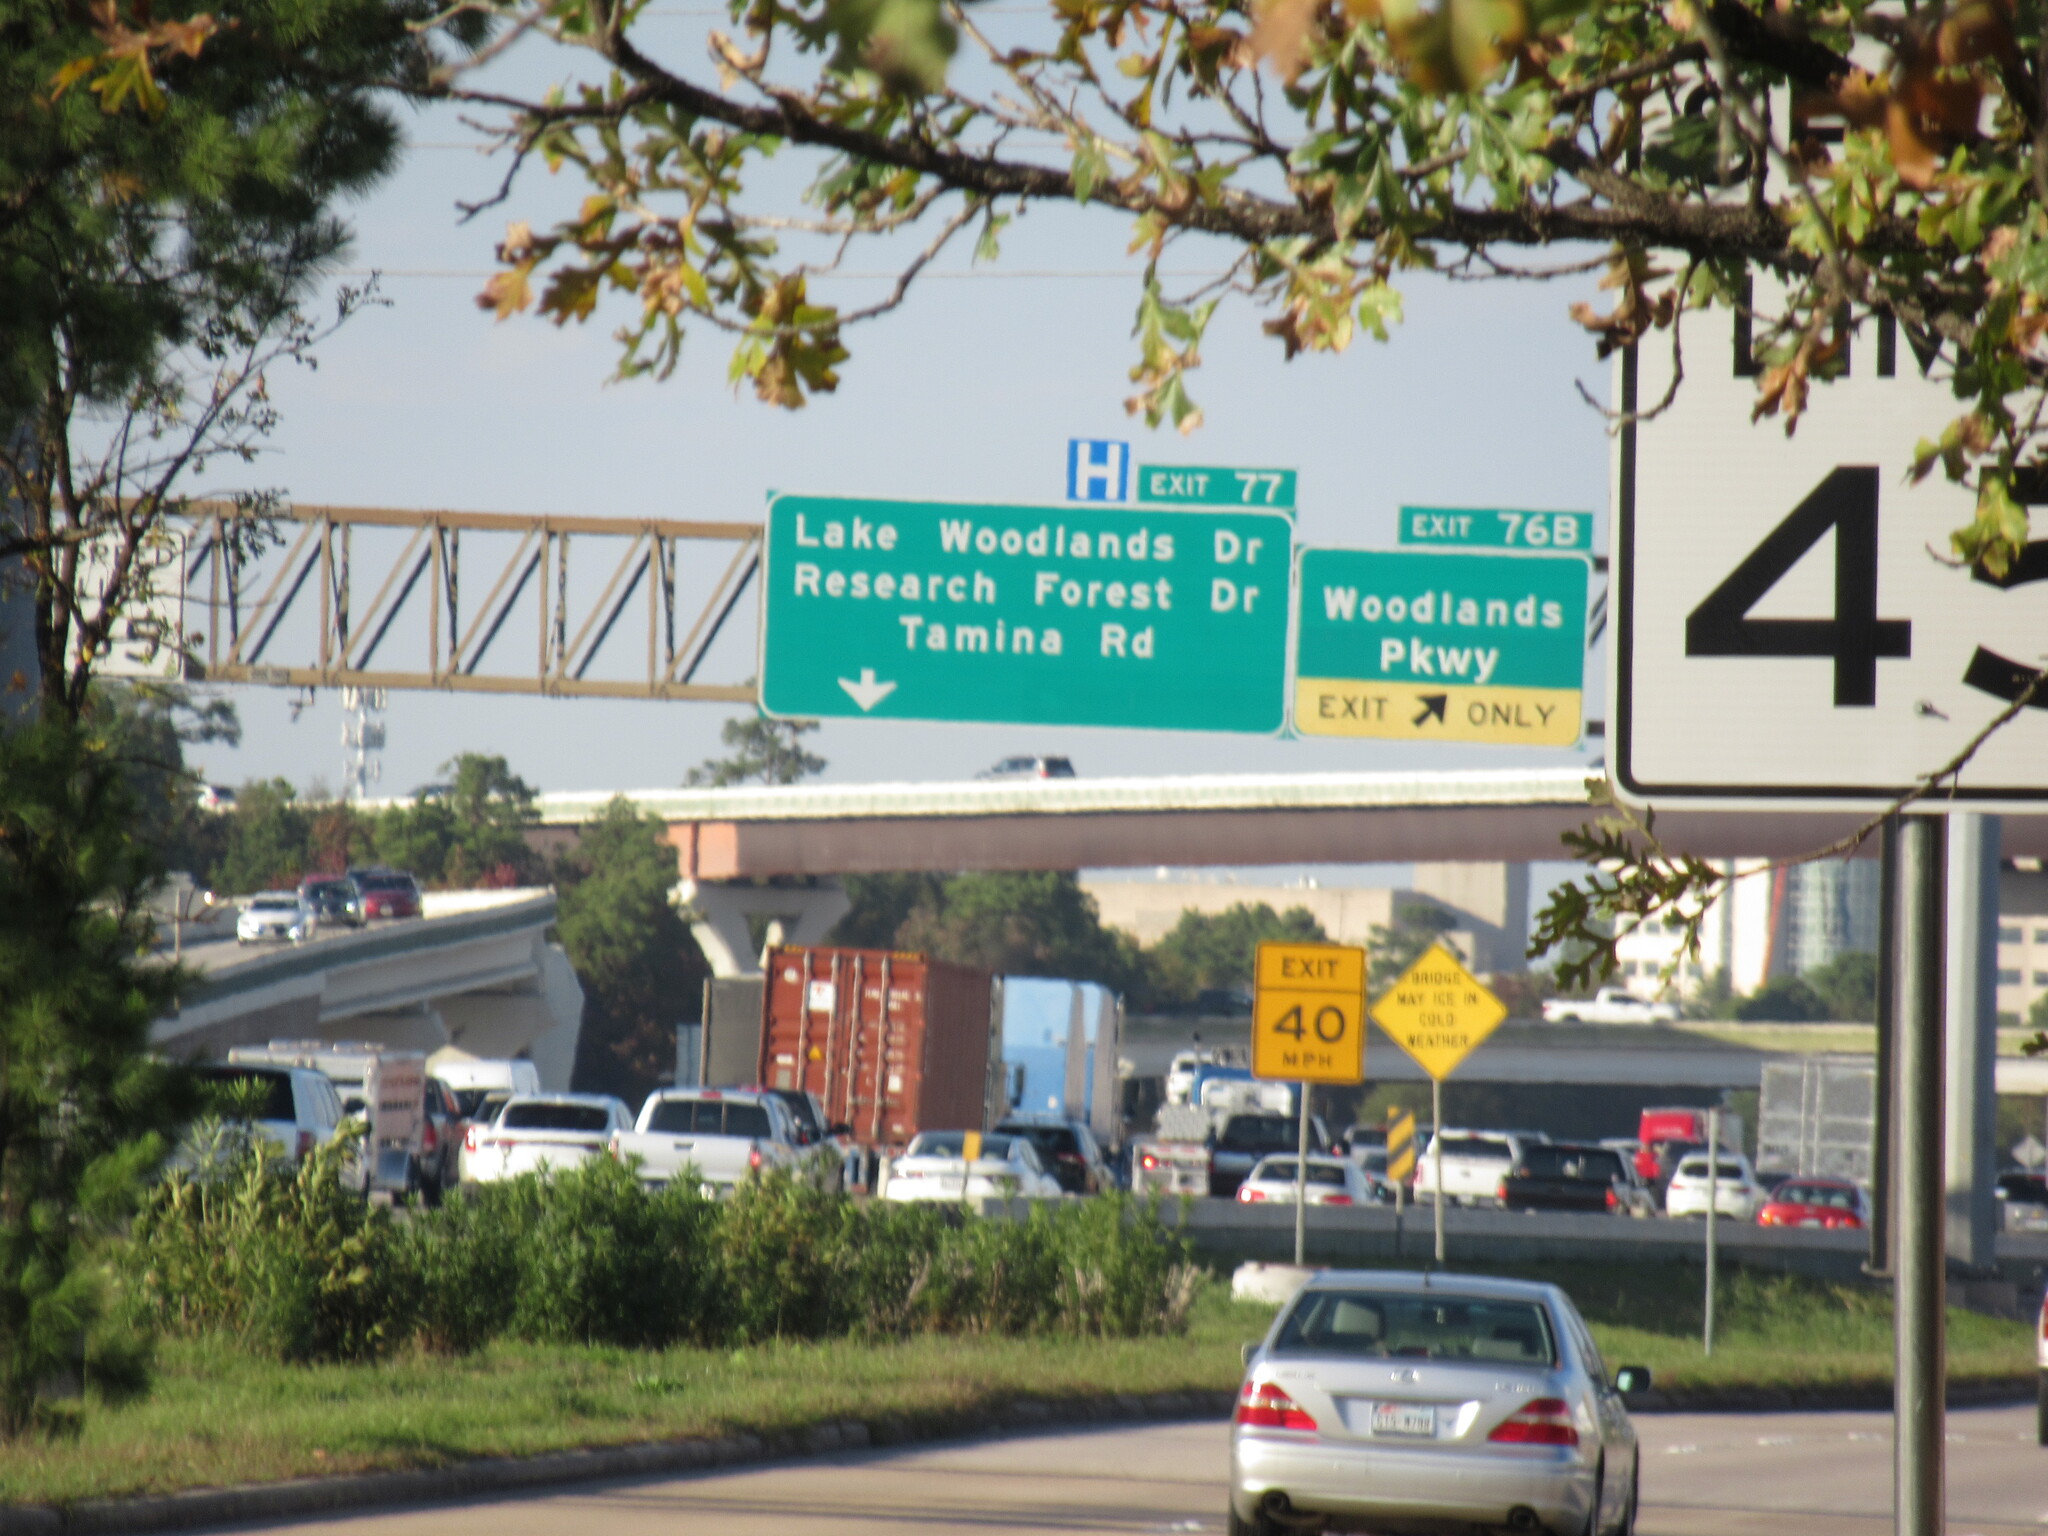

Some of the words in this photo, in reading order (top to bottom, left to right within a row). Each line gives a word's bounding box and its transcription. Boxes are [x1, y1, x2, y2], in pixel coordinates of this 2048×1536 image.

[1075, 443, 1121, 500] H
[1151, 473, 1209, 495] EXIT
[1235, 472, 1283, 503] 77
[796, 513, 899, 551] Lake
[939, 519, 1175, 561] Woodlands
[1214, 529, 1264, 565] Dr
[1411, 514, 1473, 538] EXIT
[1498, 512, 1580, 546] 76B
[794, 562, 997, 604] Research
[1035, 571, 1172, 610] Forest
[1210, 578, 1260, 613] Dr
[1323, 585, 1563, 628] Woodlands
[899, 615, 1063, 656] Tamina
[1100, 623, 1155, 659] Rd
[1380, 636, 1499, 684] Pkwy
[1318, 694, 1388, 720] EXIT
[1467, 702, 1555, 728] ONLY
[1281, 957, 1339, 979] EXIT
[1411, 971, 1461, 986] BRIDGE
[1396, 991, 1424, 1006] MAY
[1433, 992, 1455, 1006] ICE
[1463, 992, 1478, 1006] IN
[1273, 1004, 1347, 1044] 40
[1418, 1012, 1455, 1028] COLD
[1407, 1032, 1469, 1048] WEATHER
[1282, 1051, 1333, 1069] MPH
